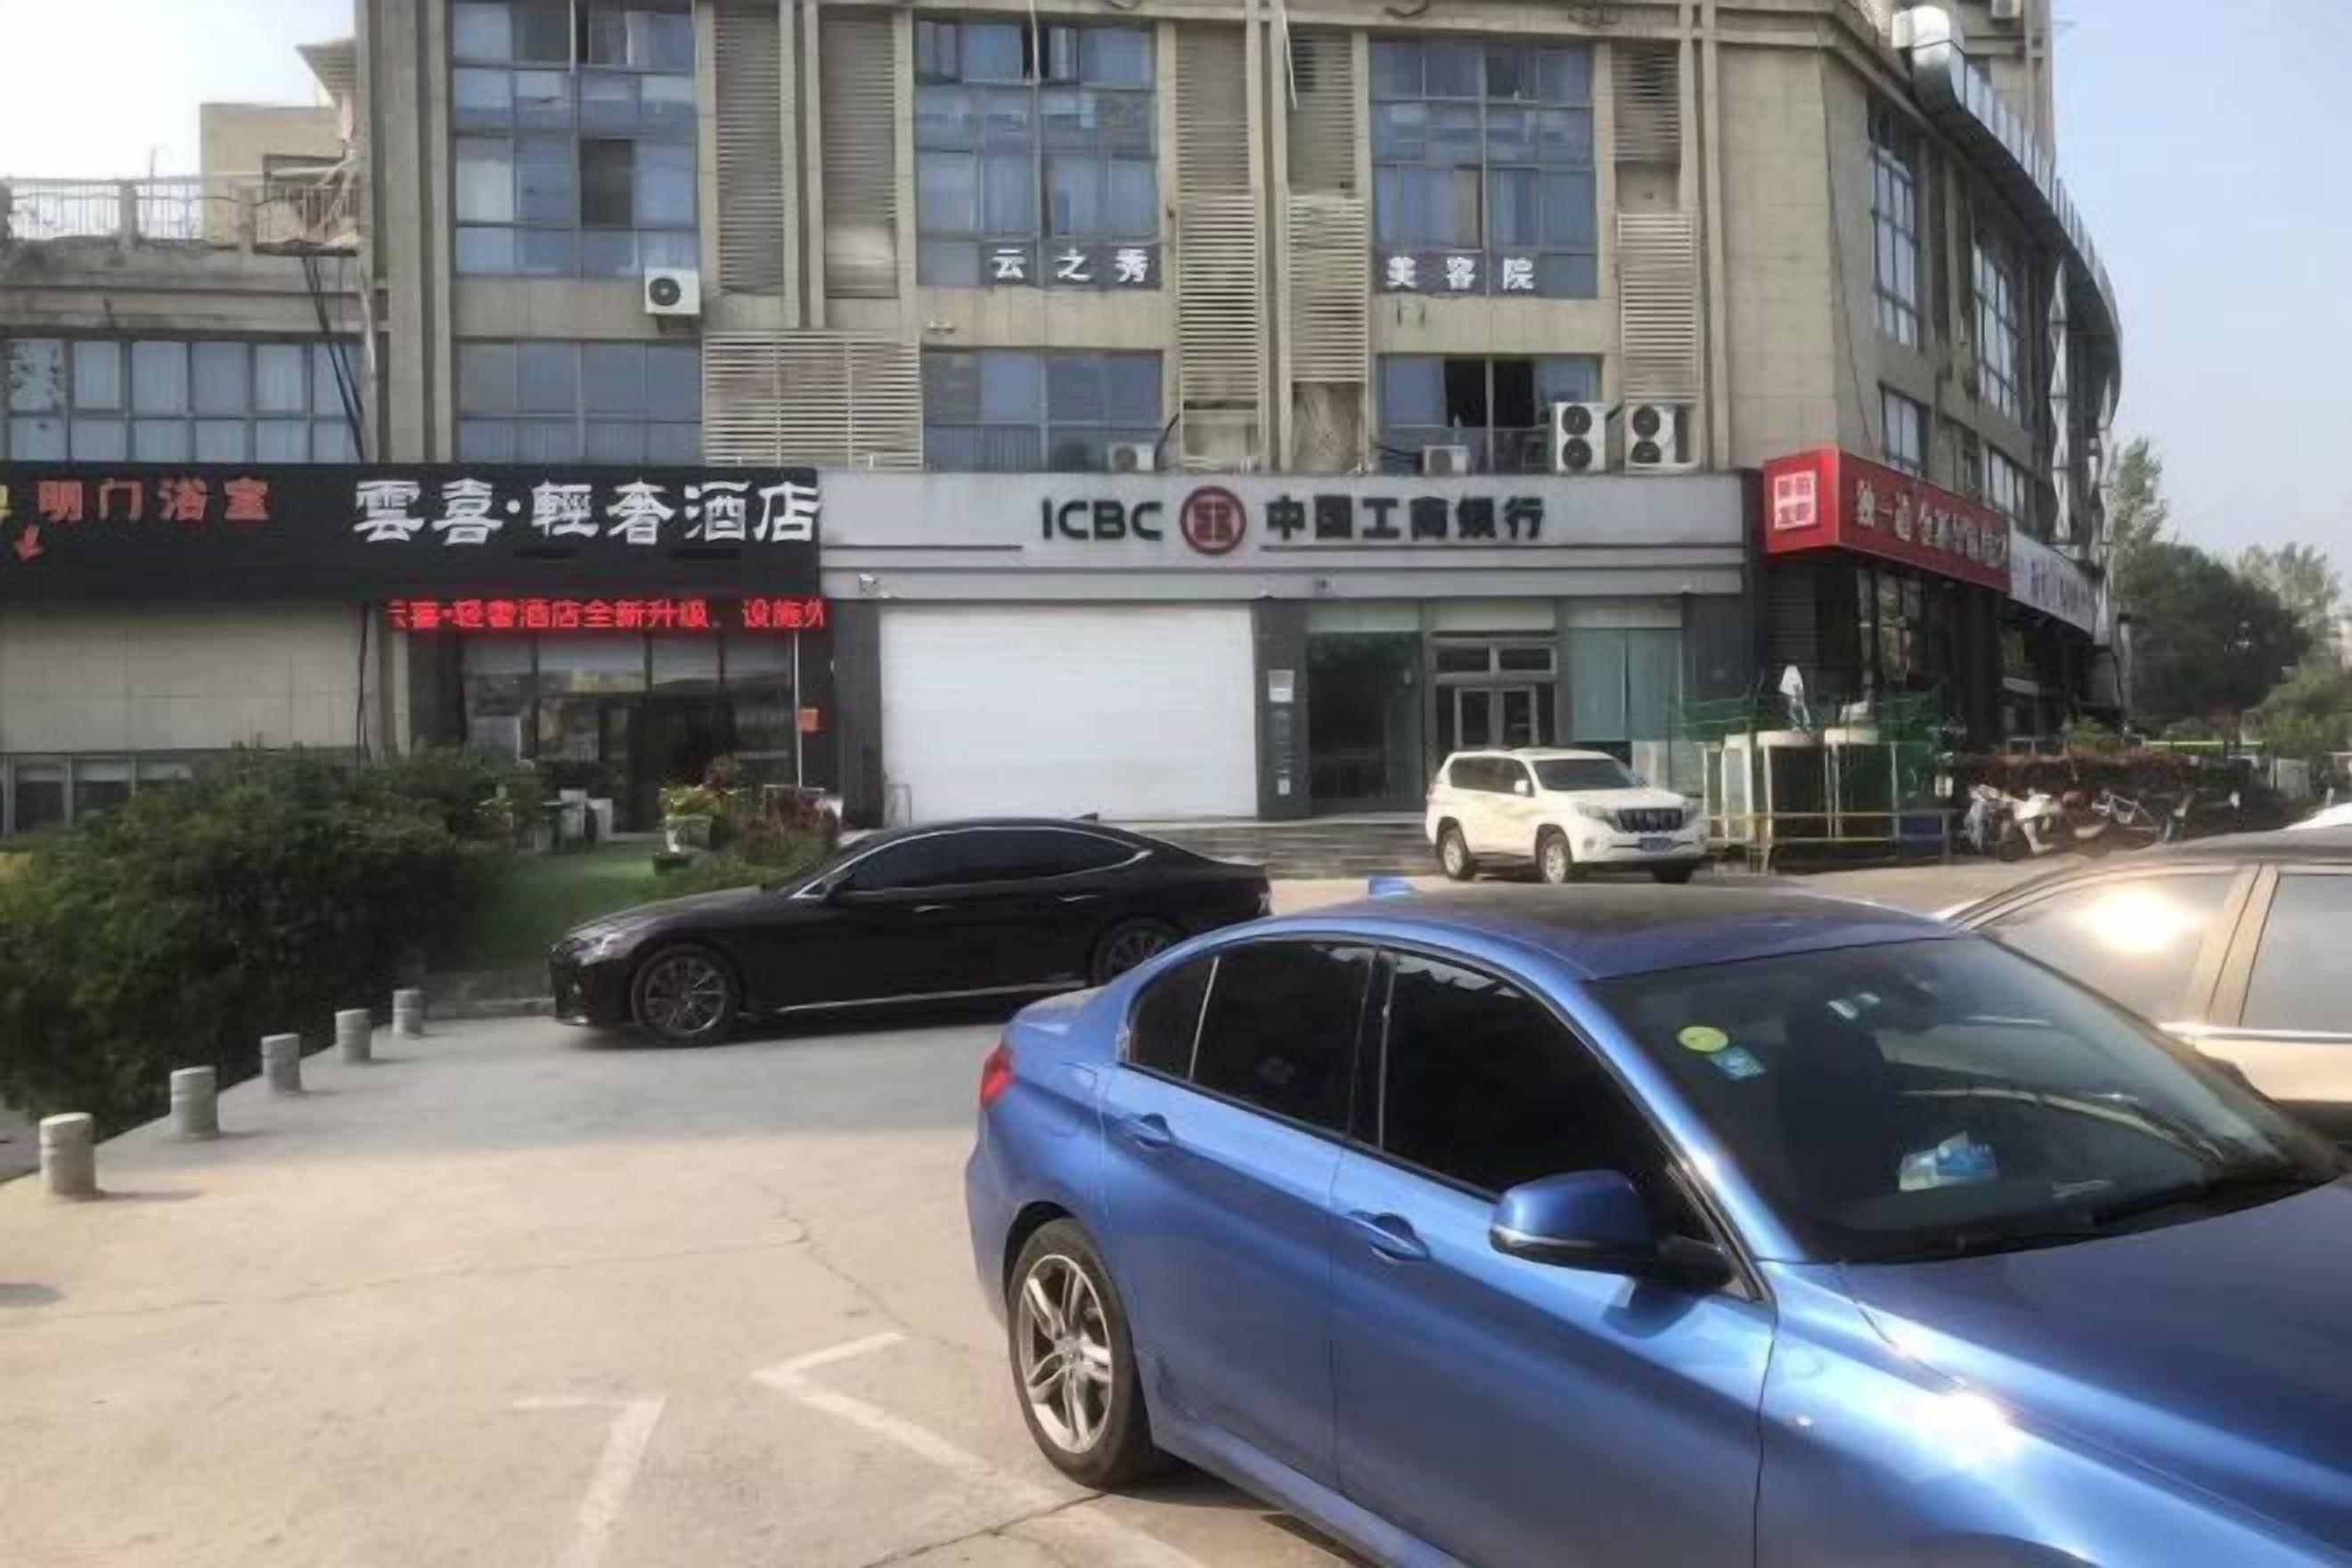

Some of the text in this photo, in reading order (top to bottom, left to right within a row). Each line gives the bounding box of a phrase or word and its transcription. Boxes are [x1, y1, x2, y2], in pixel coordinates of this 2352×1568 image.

[992, 249, 1148, 283] 云之秀
[1386, 257, 1535, 290] 美容院
[37, 477, 270, 522] 明门浴室
[1041, 494, 1545, 542] ICBC 中国工商银行
